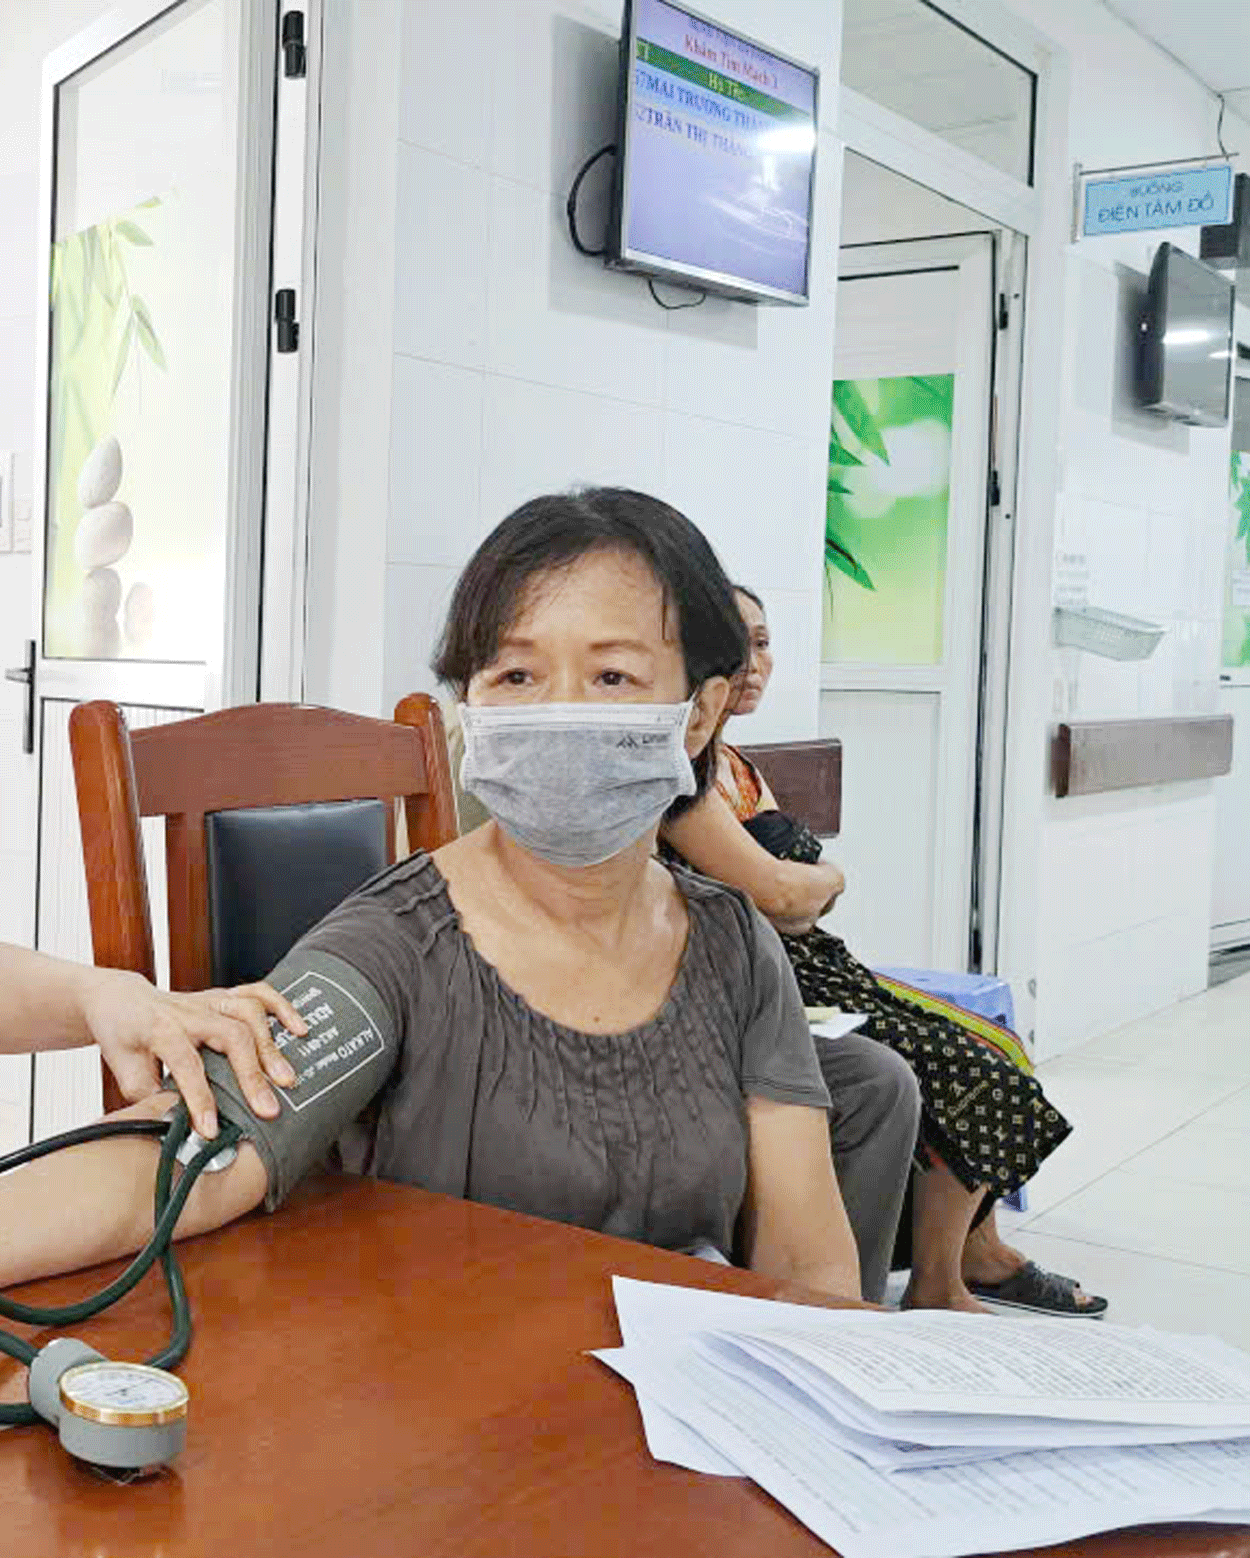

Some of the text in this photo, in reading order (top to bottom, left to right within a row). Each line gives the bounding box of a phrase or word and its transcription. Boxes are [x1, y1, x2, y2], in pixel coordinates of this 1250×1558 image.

[720, 50, 742, 74] Tim
[1145, 198, 1182, 217] TÂM
[337, 1027, 374, 1059] ALKATO
